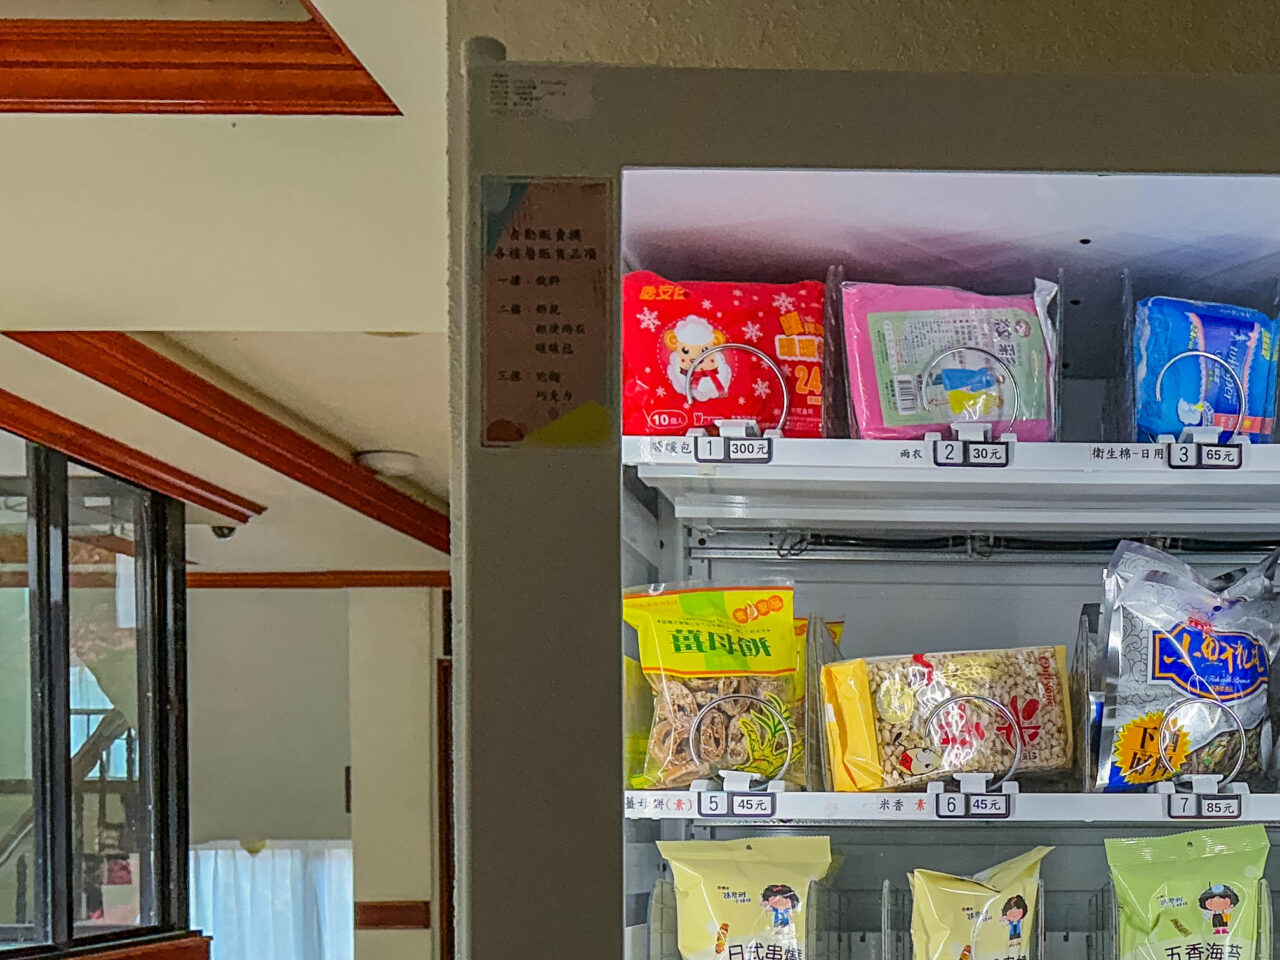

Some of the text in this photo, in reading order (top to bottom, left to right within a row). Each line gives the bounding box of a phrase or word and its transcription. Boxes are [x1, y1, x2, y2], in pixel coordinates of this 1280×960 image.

[706, 440, 713, 457] 1
[731, 443, 769, 455] 300元
[899, 448, 923, 460] 雨衣
[944, 444, 954, 461] 2
[972, 447, 1002, 461] 30元
[1179, 446, 1189, 463] 3
[1206, 449, 1235, 462] 65元
[709, 795, 719, 812] 5
[737, 799, 767, 811] 45元
[879, 797, 927, 811] 米香 素
[946, 796, 957, 813] 6
[972, 799, 1001, 811] 45元
[1180, 797, 1189, 814] 7
[1206, 802, 1235, 814] 85元
